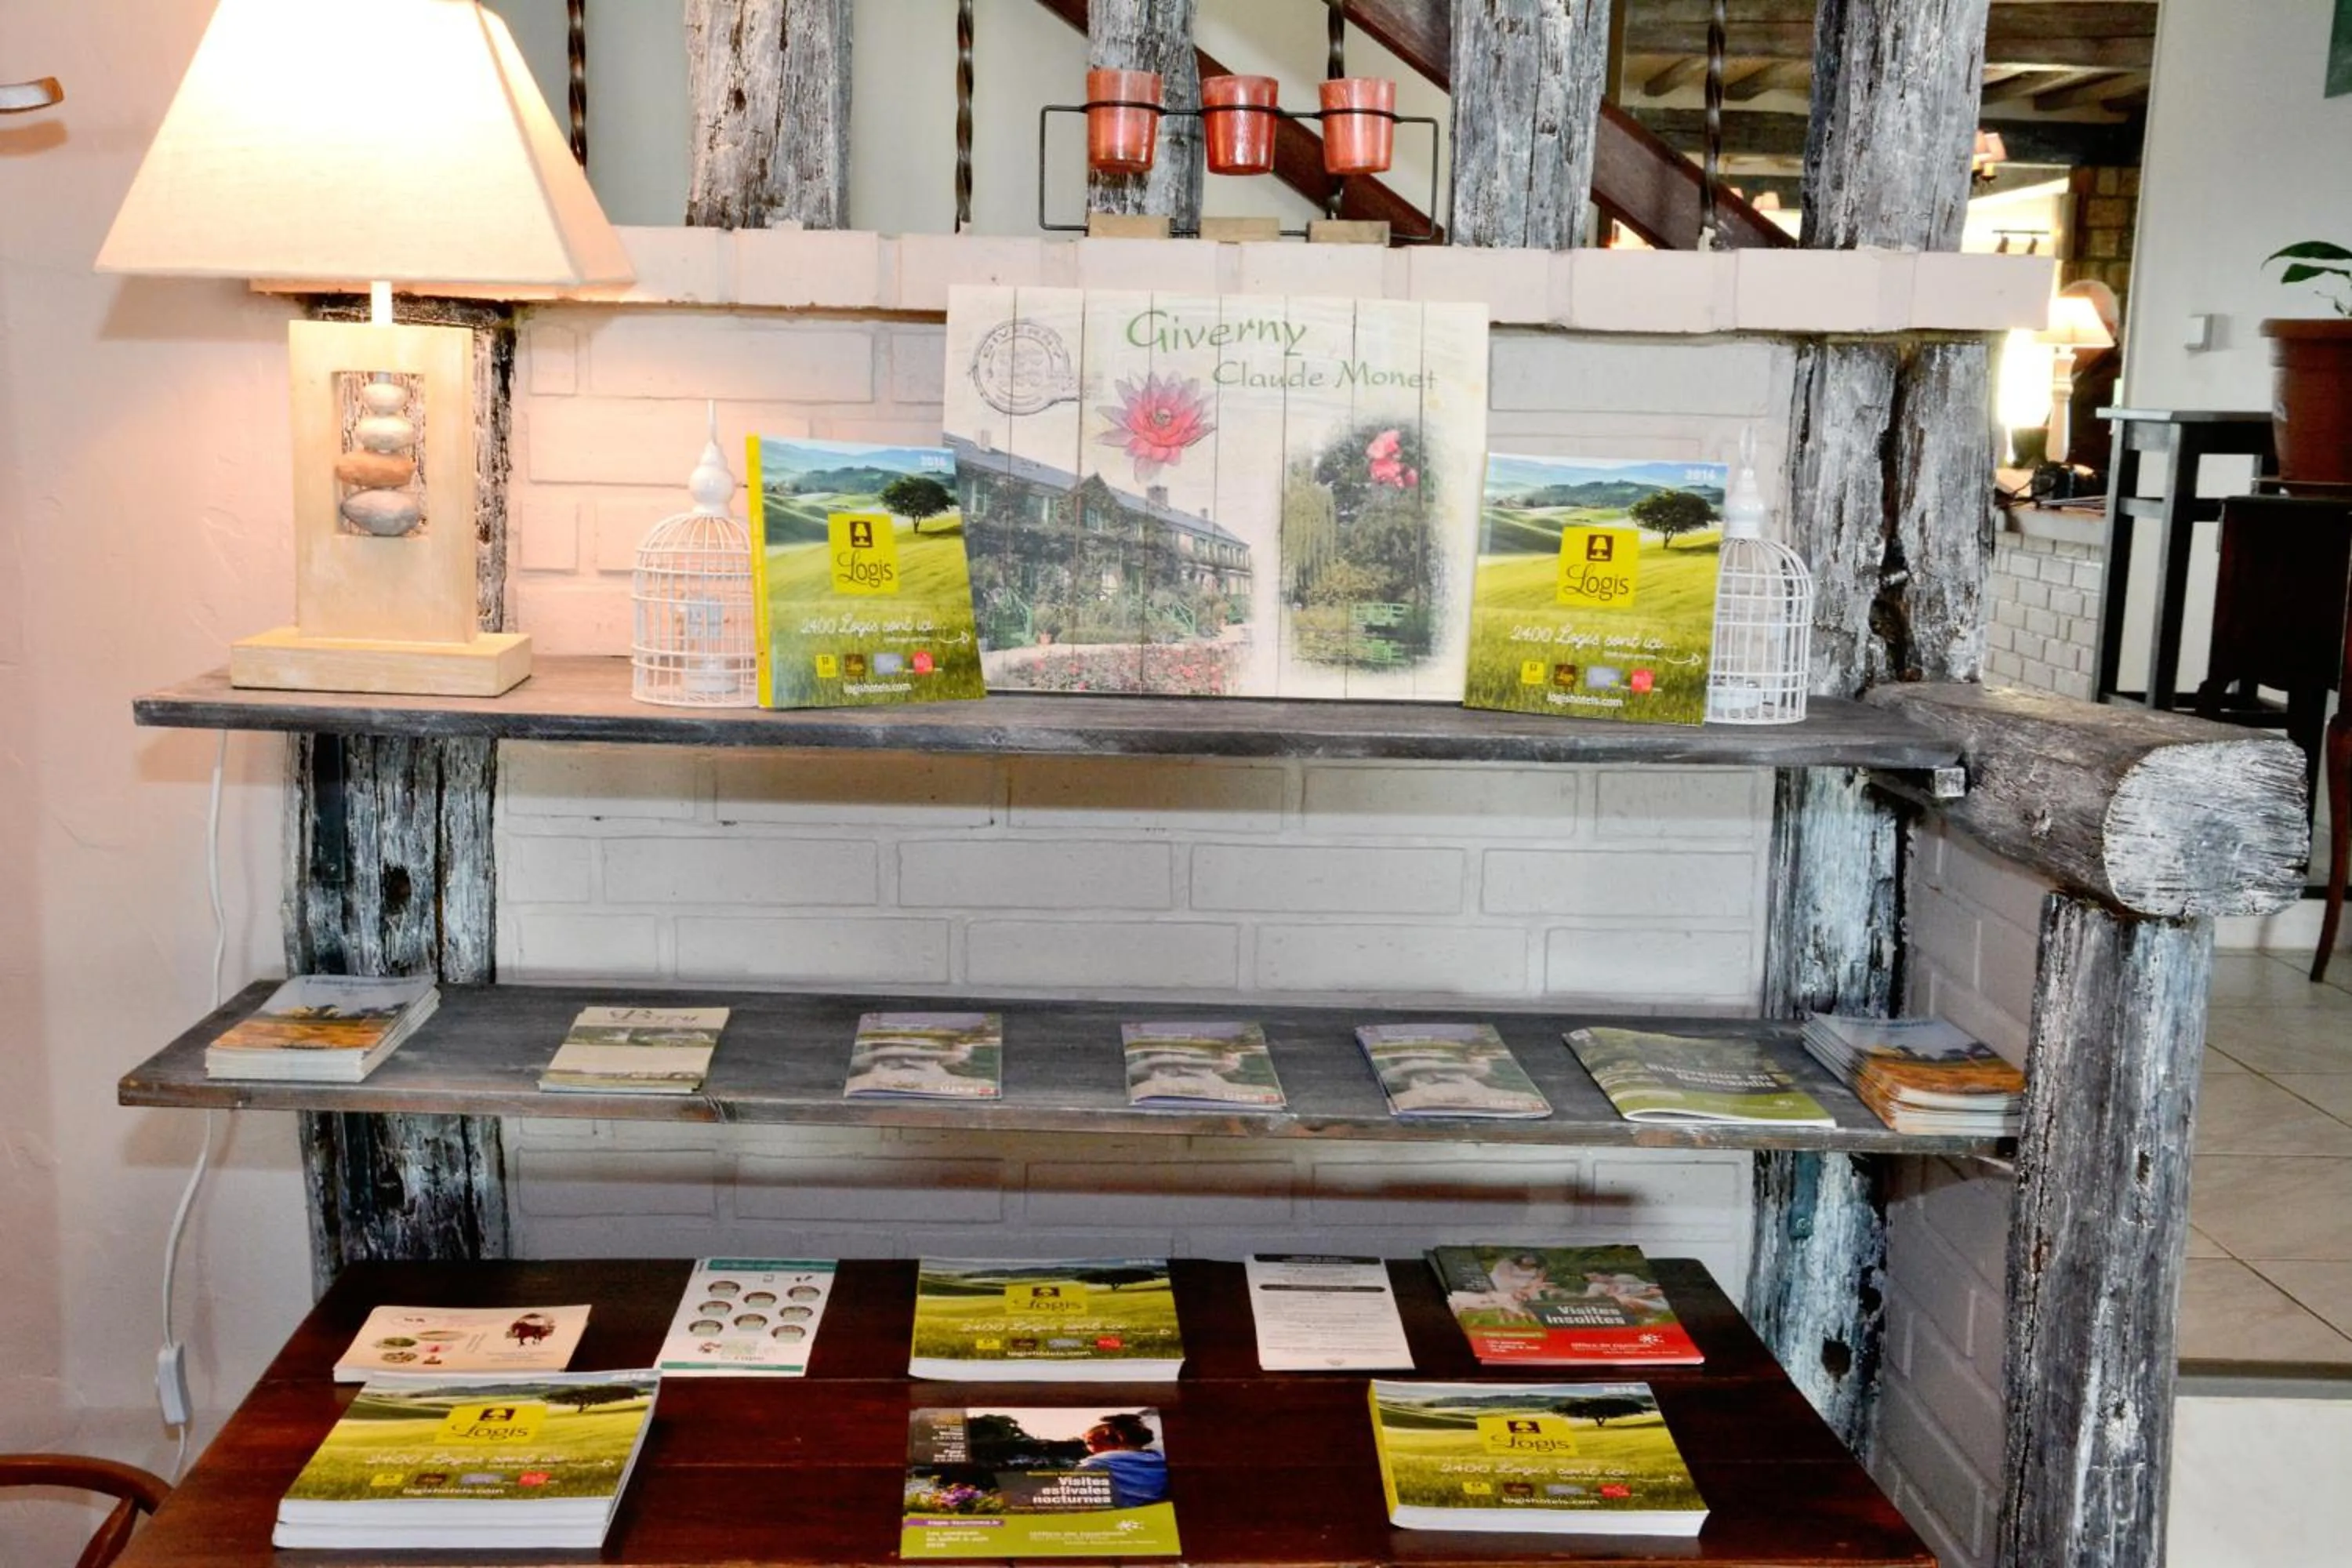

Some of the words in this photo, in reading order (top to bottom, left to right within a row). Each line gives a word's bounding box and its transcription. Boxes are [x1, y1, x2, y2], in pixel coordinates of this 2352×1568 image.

[1127, 310, 1307, 356] Giverny
[1213, 361, 1323, 389] Claude
[1335, 361, 1437, 390] Monet
[837, 551, 893, 587] Logis
[1564, 564, 1629, 601] Logis
[800, 618, 837, 634] 2400
[1510, 625, 1552, 642] 2400
[1555, 623, 1599, 650] Logis
[1013, 1298, 1083, 1312] Logis
[1557, 1305, 1621, 1316] Visites
[452, 1425, 528, 1441] Logis
[1490, 1434, 1570, 1453] Logis
[1058, 1476, 1110, 1486] Visites
[1042, 1486, 1111, 1495] estivales
[1033, 1495, 1111, 1504] nocturnes
